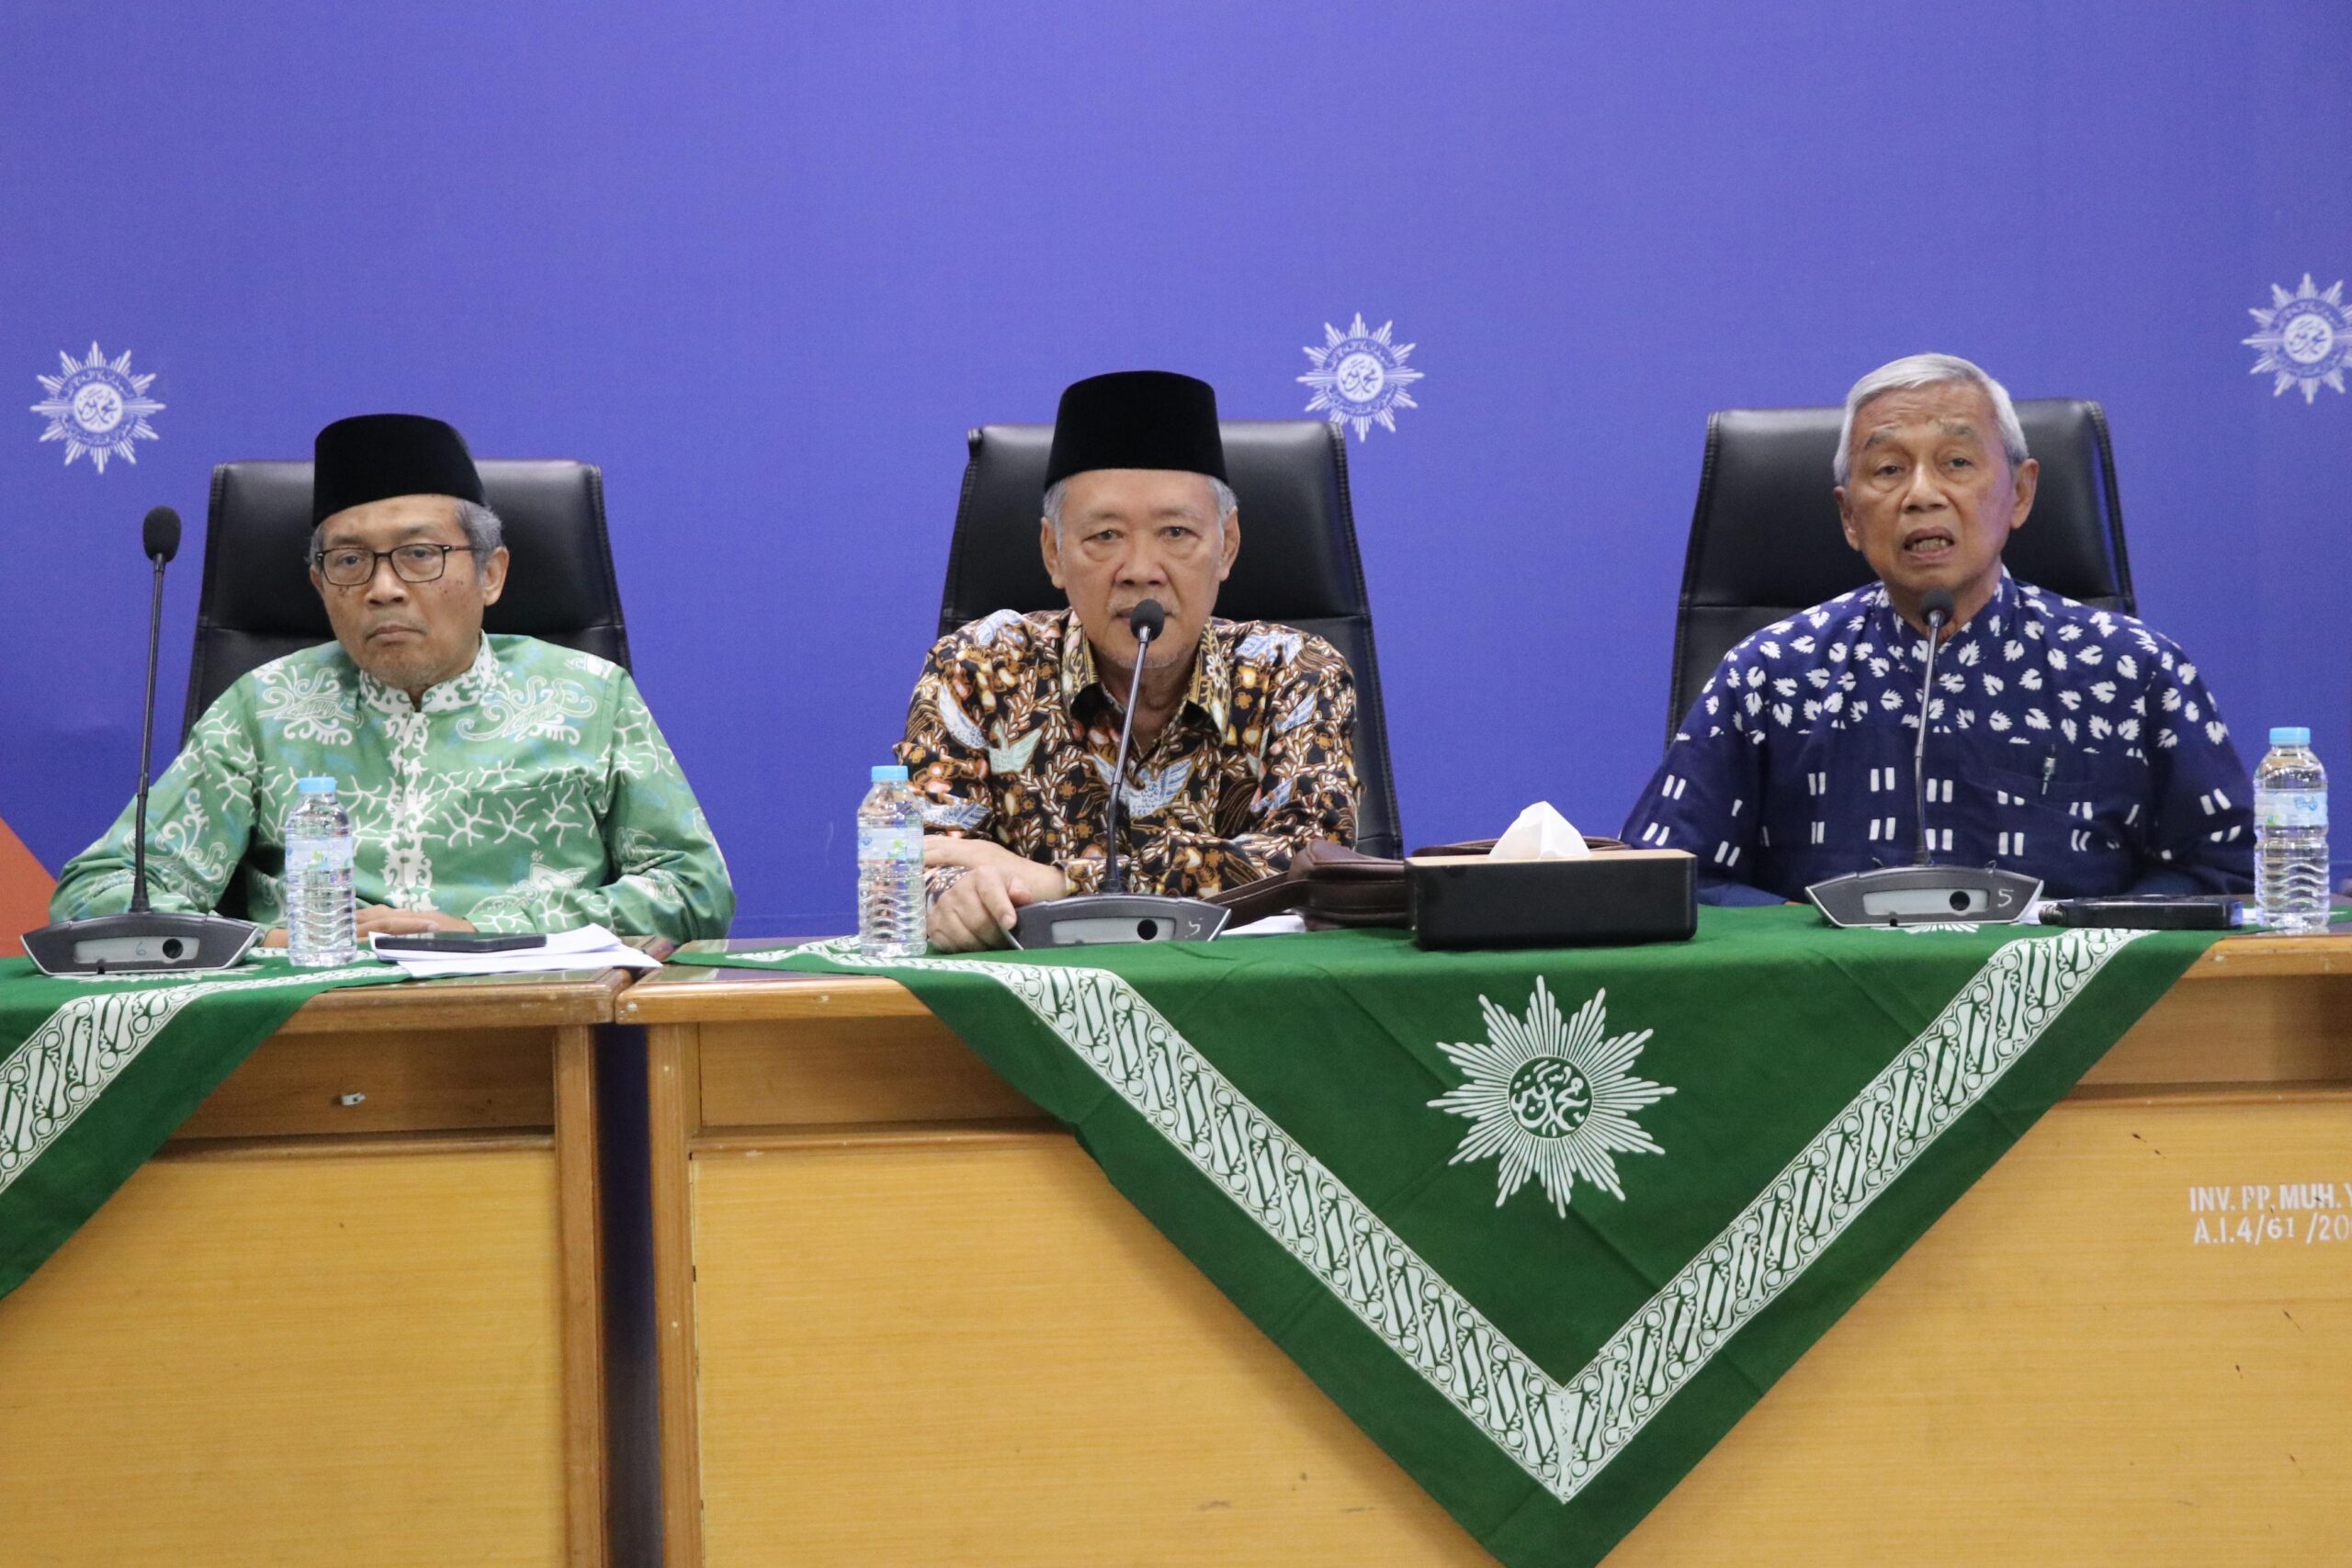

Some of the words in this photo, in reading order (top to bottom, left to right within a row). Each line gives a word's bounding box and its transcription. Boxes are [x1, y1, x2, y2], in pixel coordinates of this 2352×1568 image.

[1997, 887, 2014, 908] 5
[135, 940, 148, 956] 6
[2189, 1185, 2236, 1213] INV.
[2279, 1182, 2342, 1210] MUH.
[2305, 1212, 2352, 1245] /20
